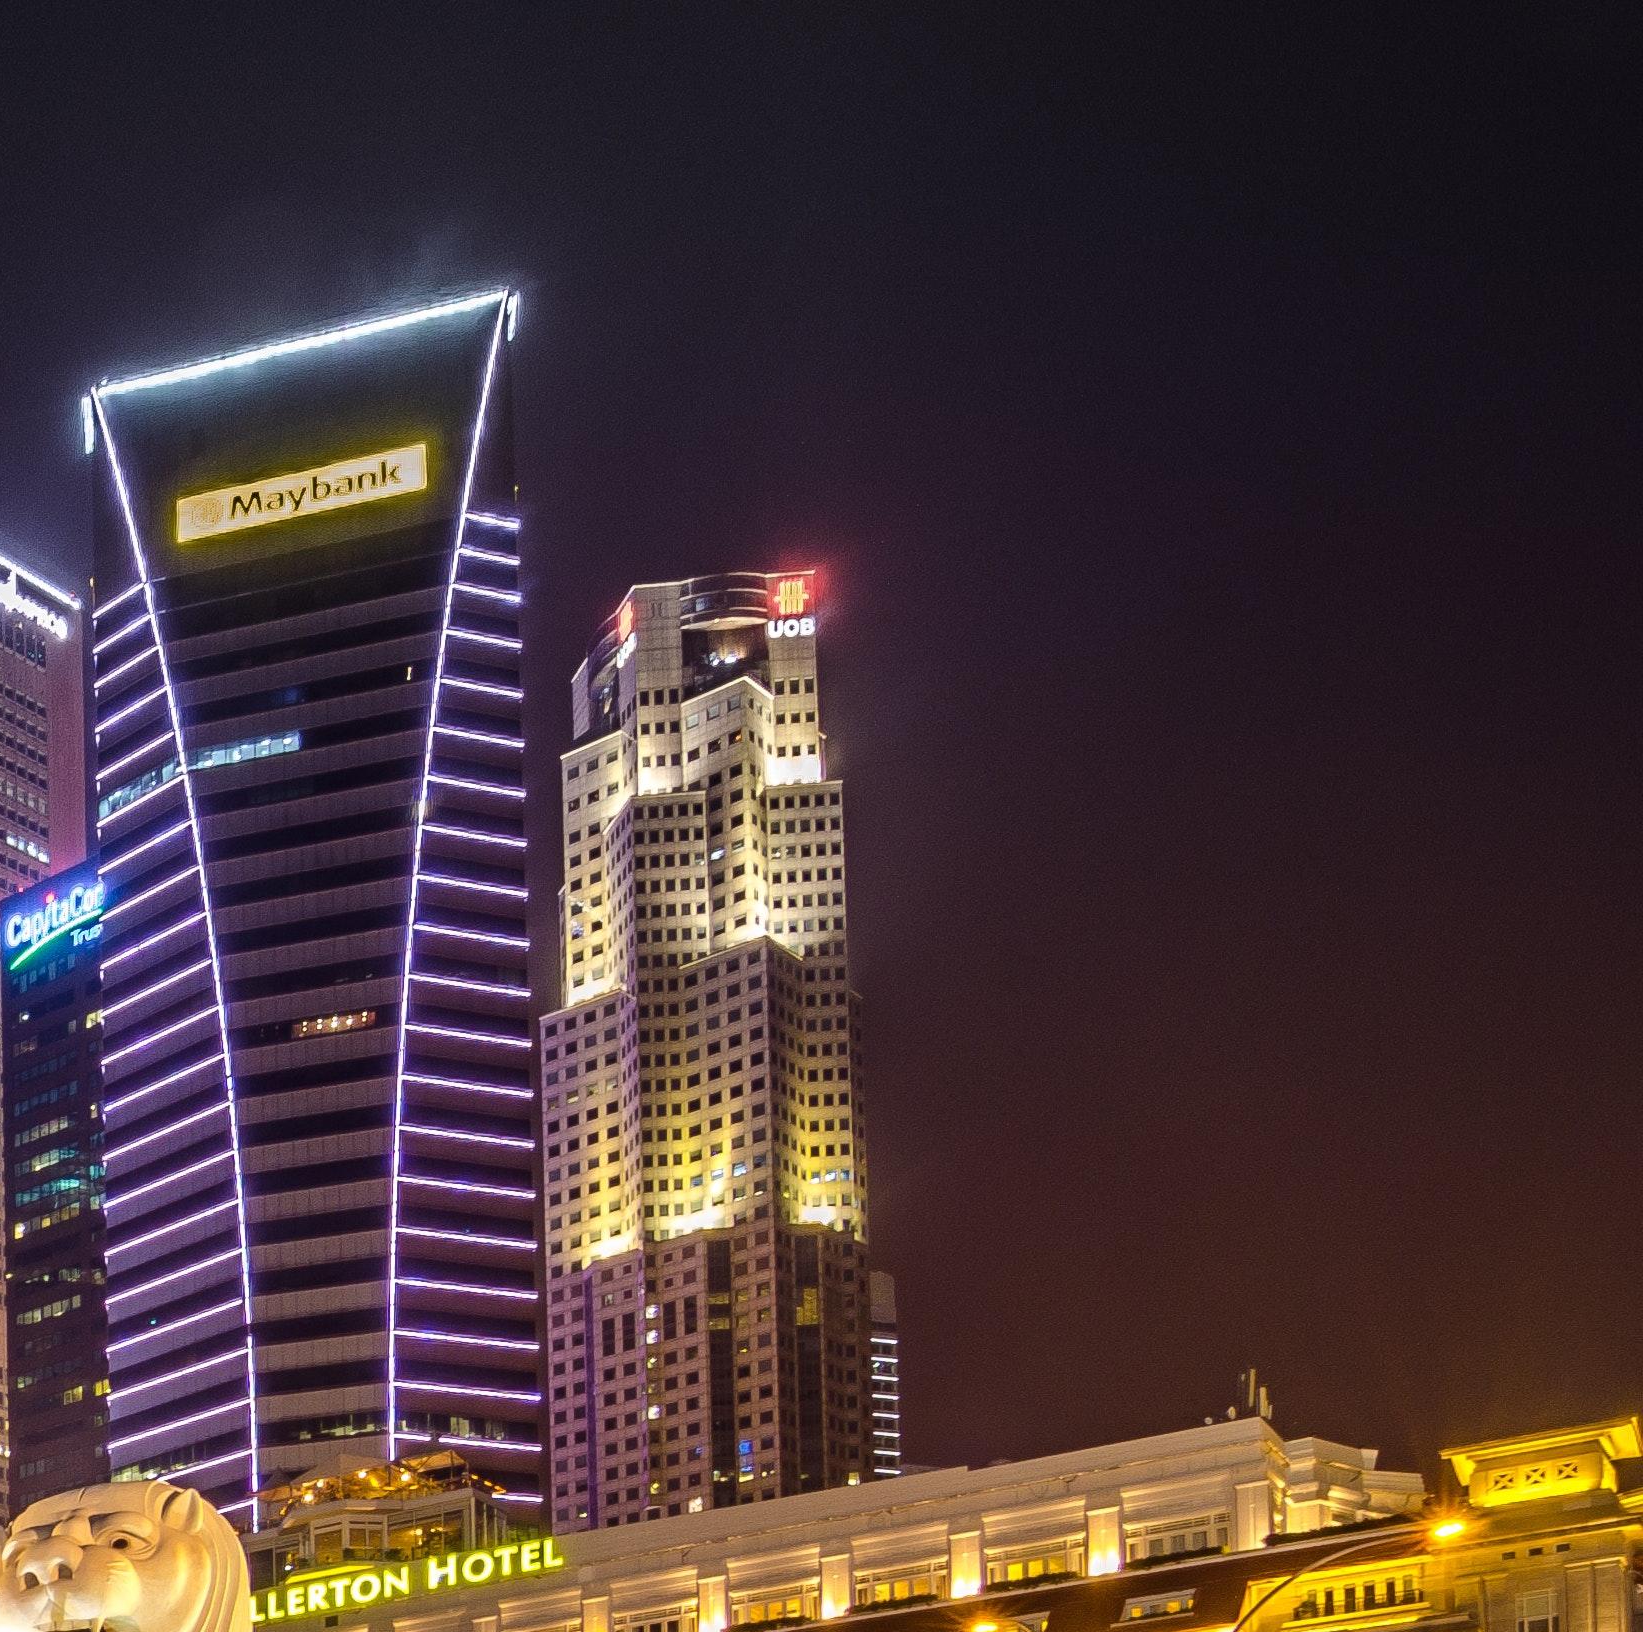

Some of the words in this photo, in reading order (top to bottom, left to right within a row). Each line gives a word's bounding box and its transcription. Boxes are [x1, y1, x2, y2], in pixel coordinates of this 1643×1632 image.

[229, 460, 402, 519] Maybank
[767, 618, 815, 638] UOB
[427, 1537, 563, 1590] HOTEL
